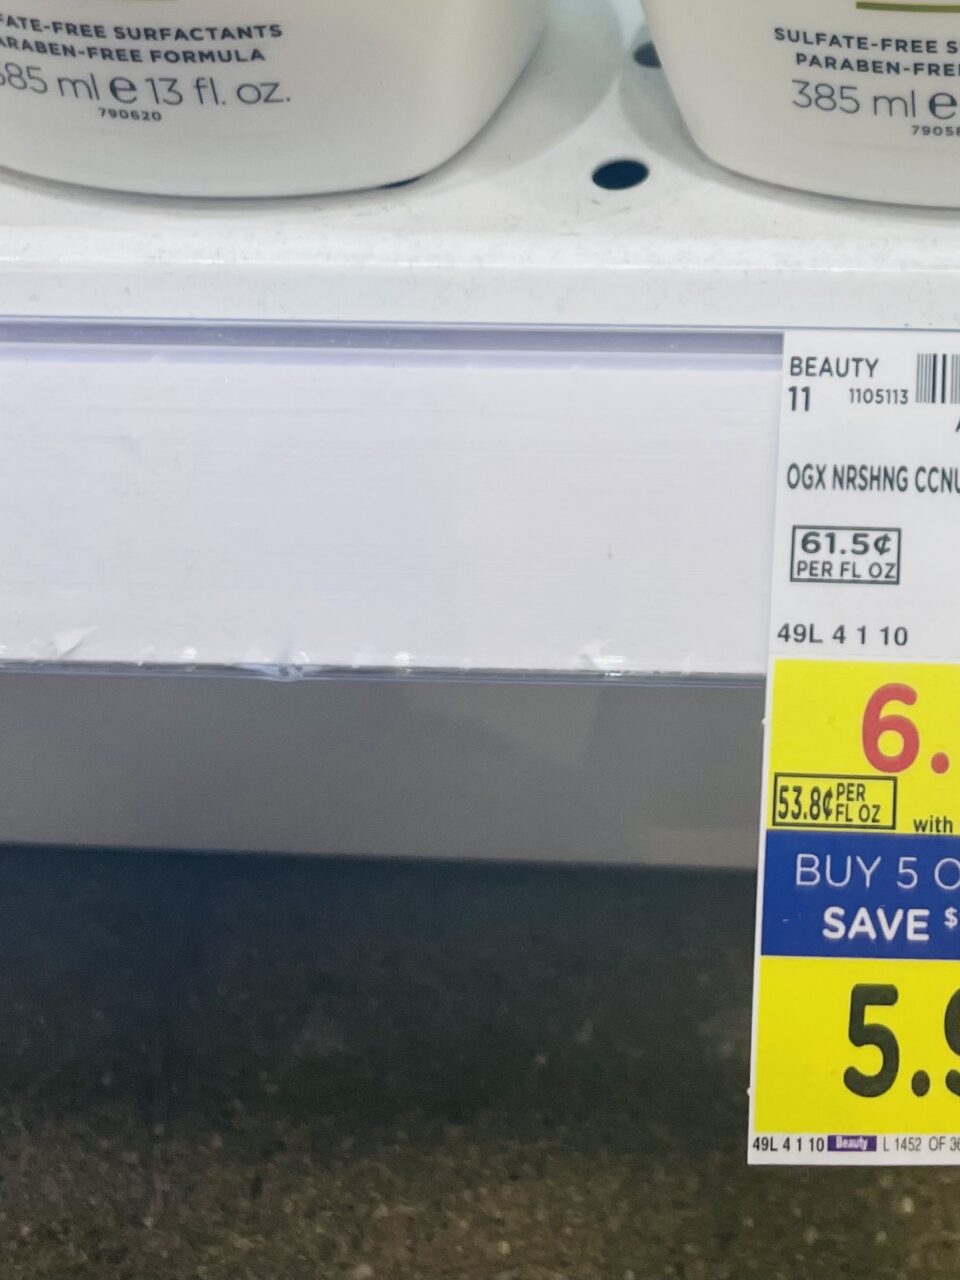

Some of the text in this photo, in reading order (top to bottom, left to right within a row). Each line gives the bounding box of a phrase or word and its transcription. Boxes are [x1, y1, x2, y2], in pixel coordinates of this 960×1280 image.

[0, 13, 283, 42] ATE-FREE SURFACTANTS
[774, 26, 938, 54] SULFATE-FREE
[150, 47, 265, 63] FORMULA
[0, 61, 47, 95] 85
[57, 72, 100, 101] ml
[145, 77, 183, 106] 13
[194, 77, 226, 106] fl.
[237, 81, 291, 105] oz.
[791, 79, 860, 114] 385
[873, 90, 916, 118] ml
[98, 107, 162, 122] 790620
[790, 356, 879, 378] BEAUTY
[788, 386, 909, 412] 11 1105113
[786, 463, 827, 490] OGX
[832, 464, 909, 492] NRSHNG
[800, 531, 893, 556] 61.5¢
[797, 561, 897, 580] PER FL OZ
[777, 624, 909, 646] 49L 4 1 10
[778, 785, 833, 821] 53.8¢
[836, 782, 866, 802] PER
[836, 803, 881, 823] FL OZ
[913, 815, 953, 833] with
[795, 853, 882, 889] BUY
[897, 856, 918, 889] 5
[822, 907, 930, 941] SAVE
[753, 1136, 778, 1152] 49L
[783, 1137, 791, 1152] 4
[796, 1137, 802, 1152] 1
[809, 1137, 824, 1152] 10
[835, 1134, 869, 1151] Beauty
[883, 1136, 890, 1152] L
[894, 1136, 922, 1152] 1452
[928, 1136, 946, 1151] OF
